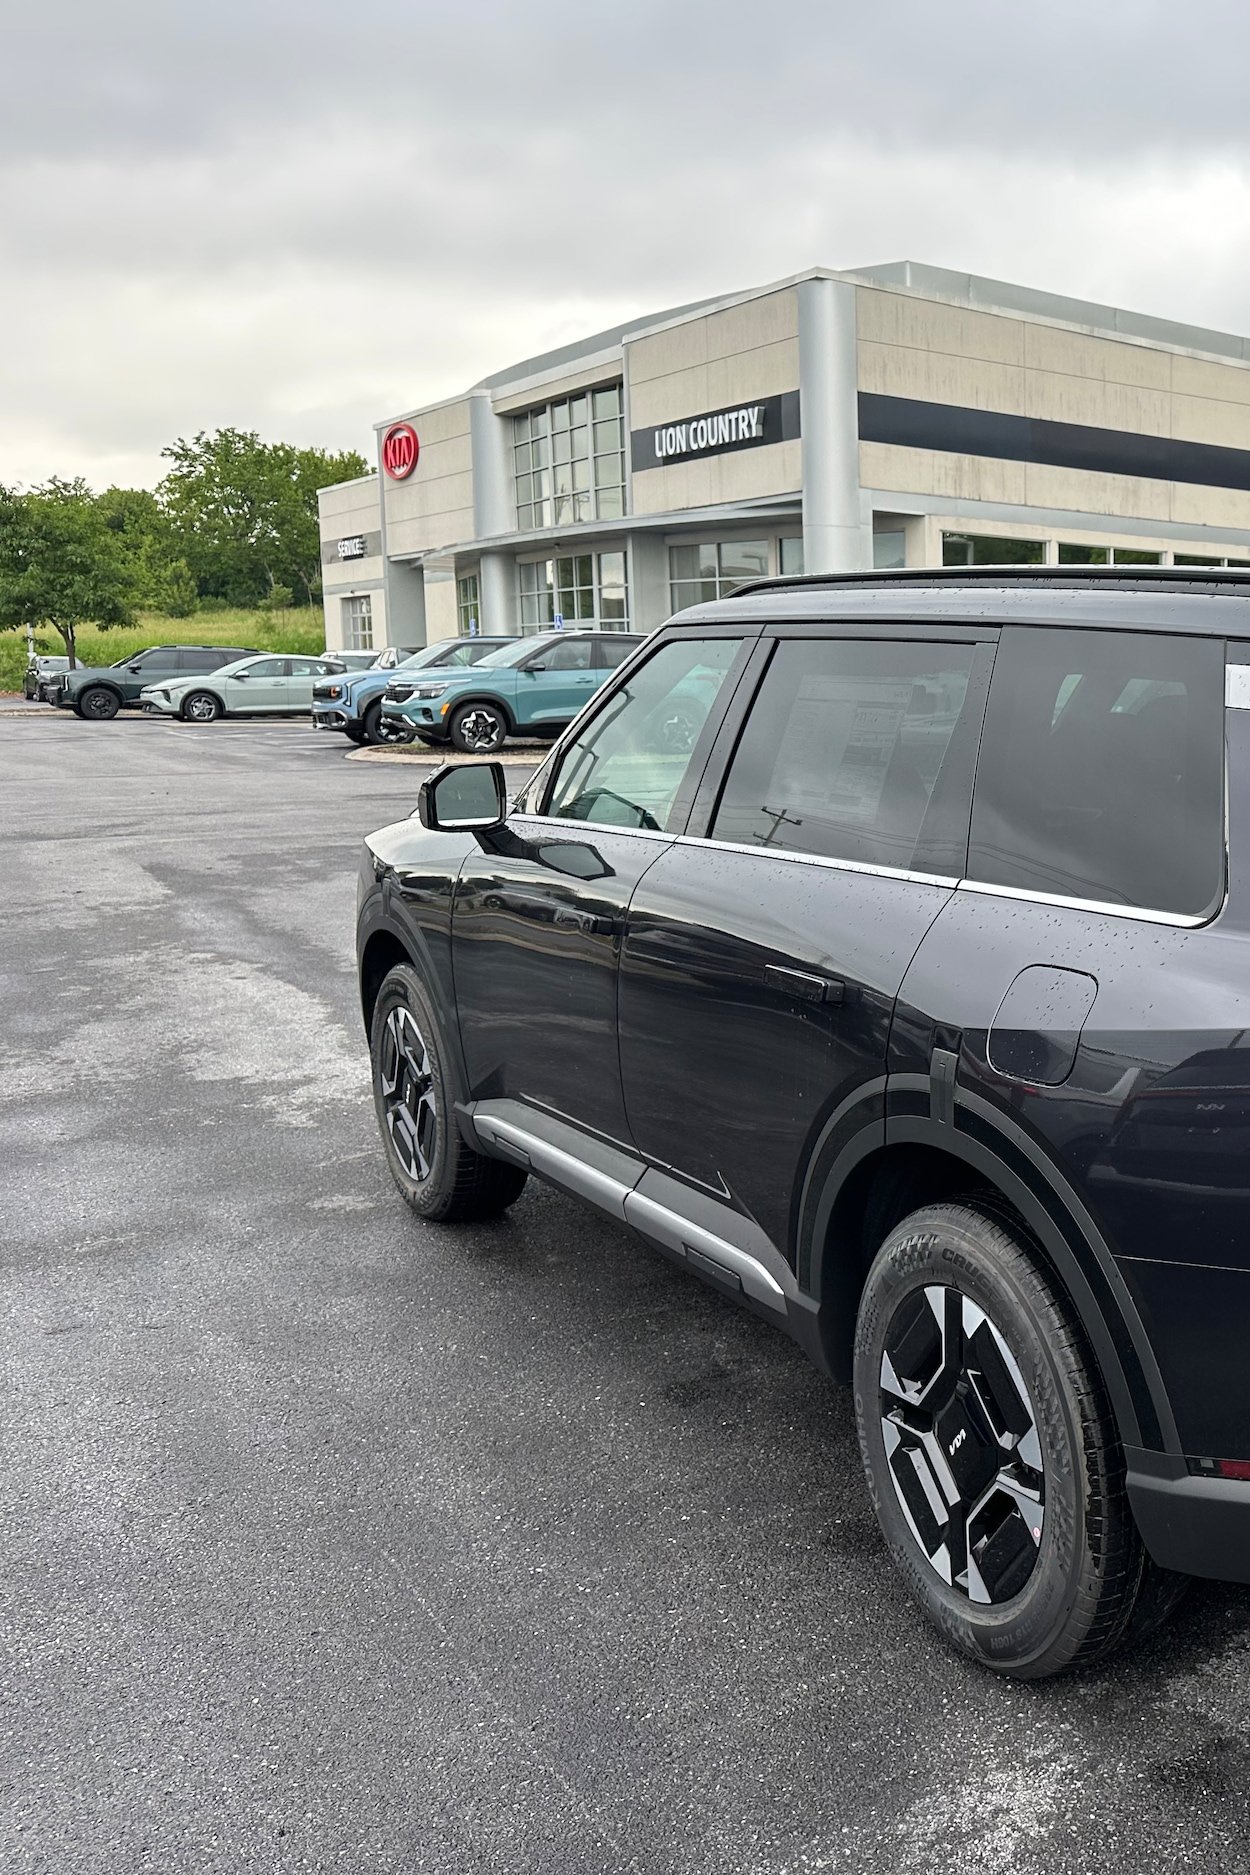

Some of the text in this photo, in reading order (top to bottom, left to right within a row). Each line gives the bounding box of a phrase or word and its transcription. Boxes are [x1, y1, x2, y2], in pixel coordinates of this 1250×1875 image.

[655, 406, 762, 457] LION COUNTRY
[337, 537, 364, 557] SERVICE
